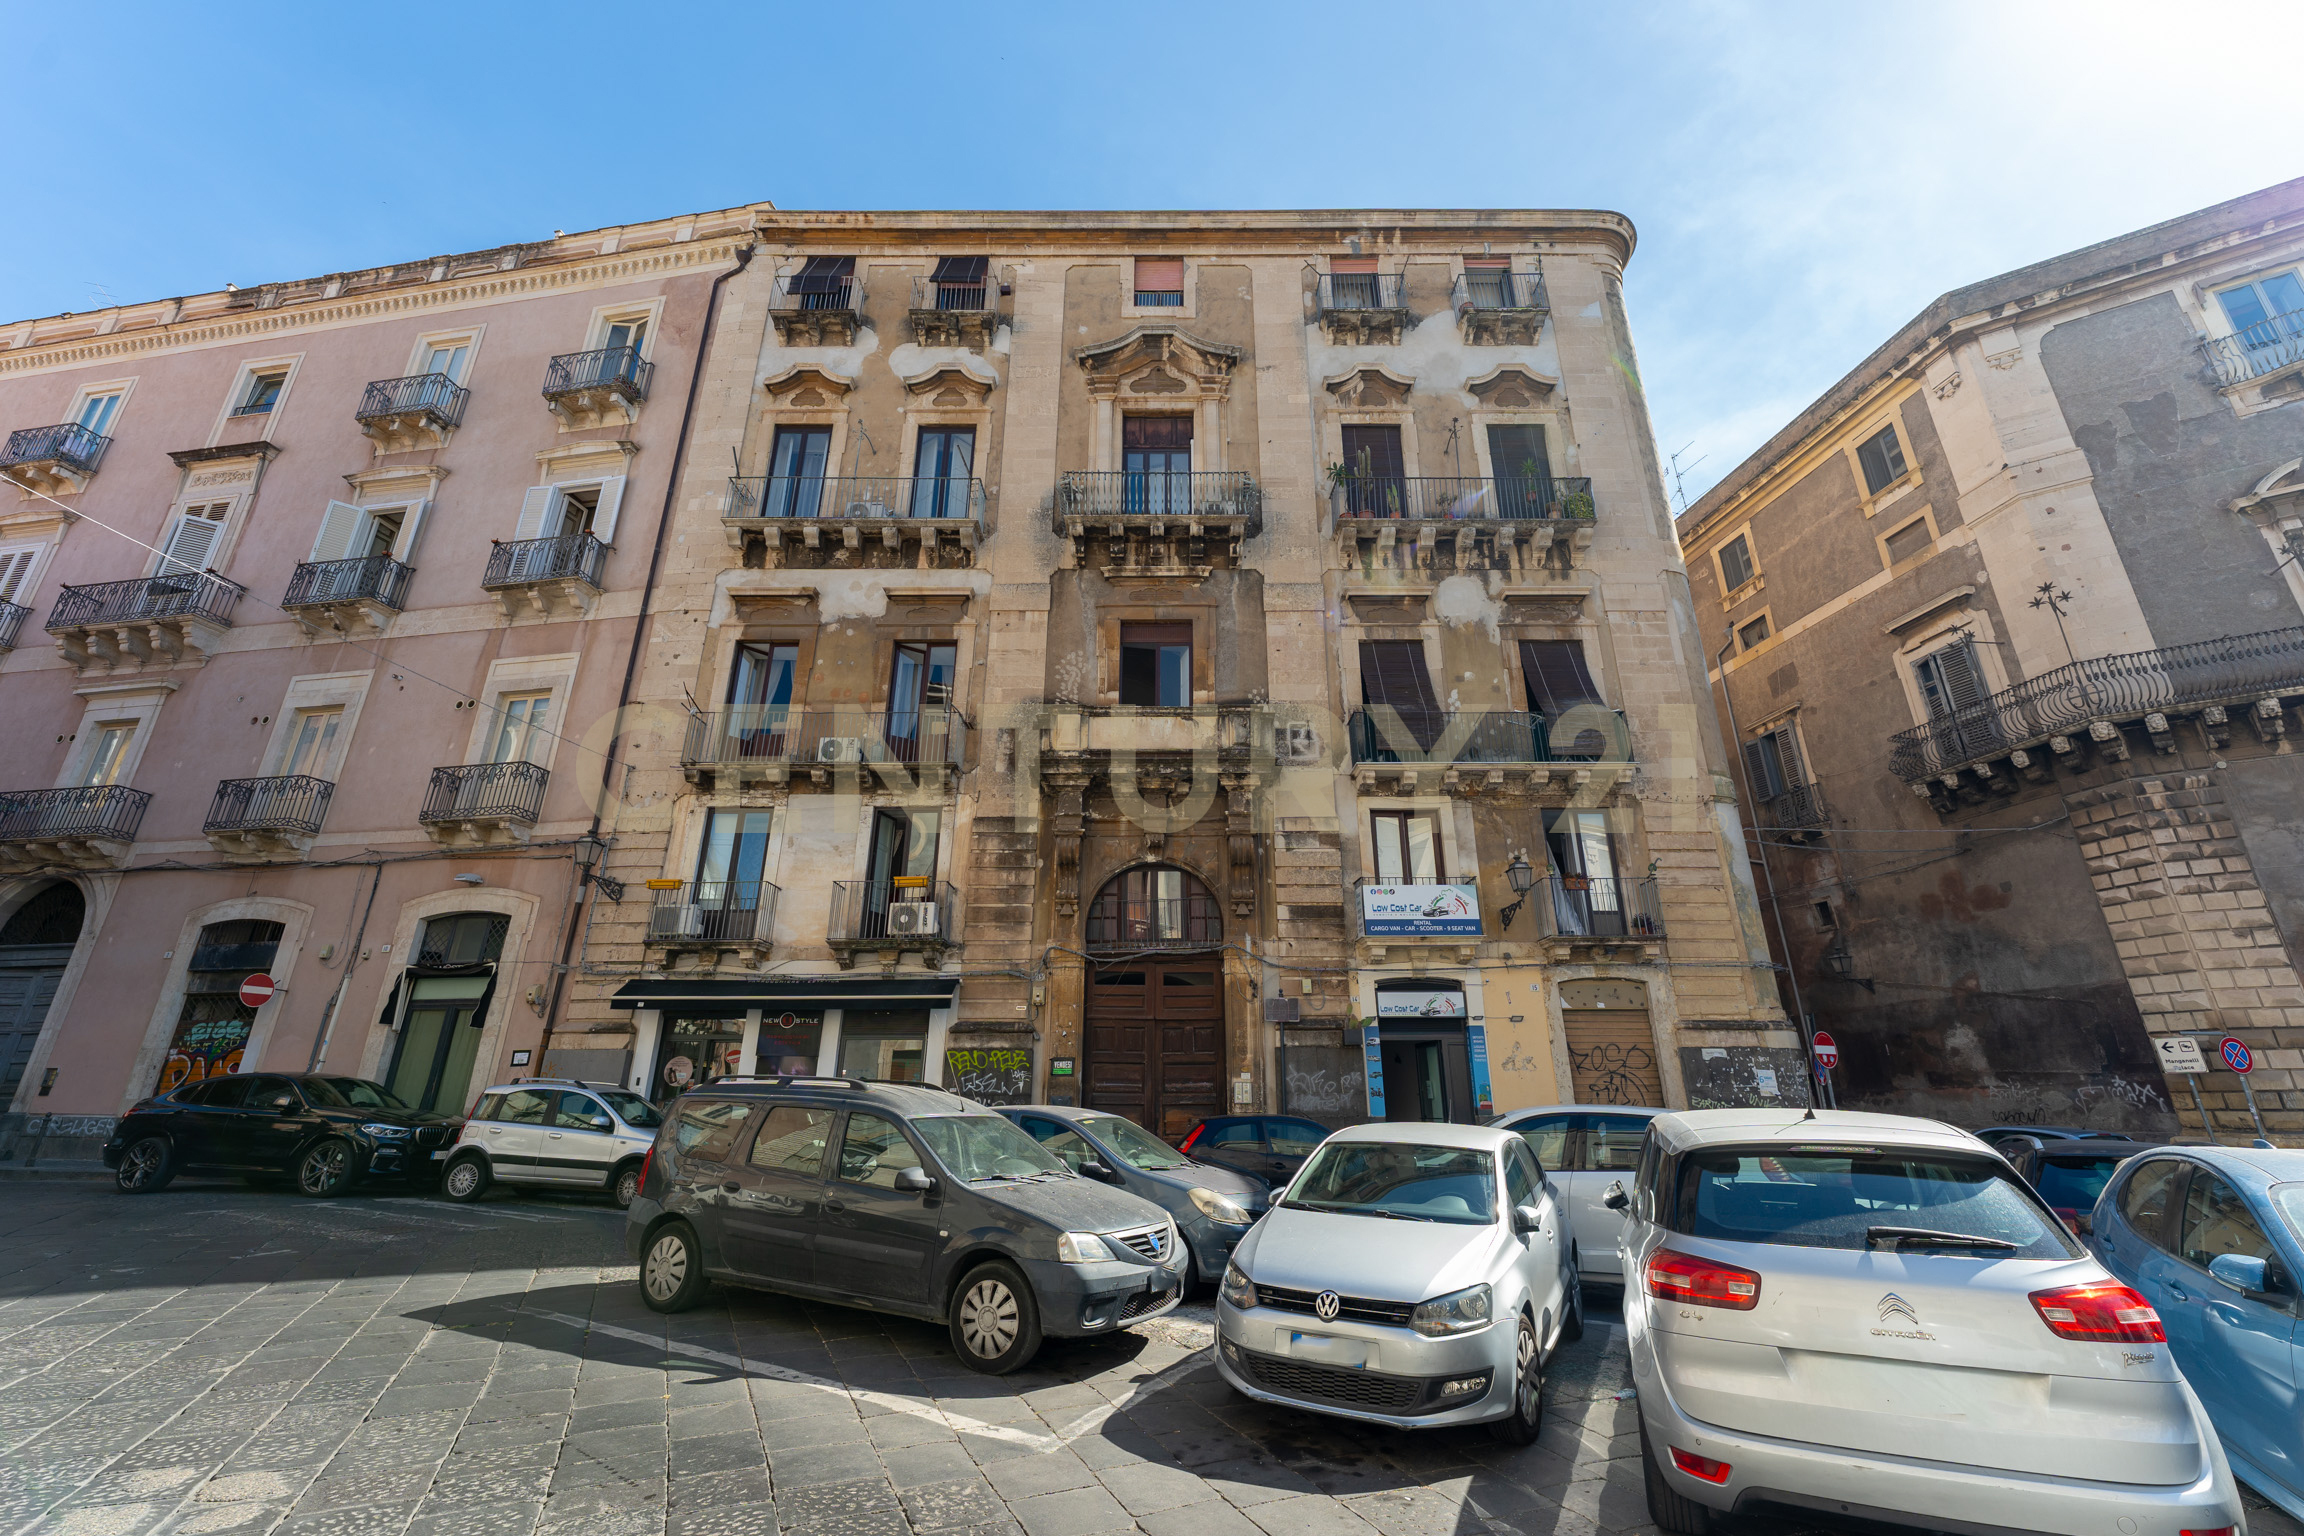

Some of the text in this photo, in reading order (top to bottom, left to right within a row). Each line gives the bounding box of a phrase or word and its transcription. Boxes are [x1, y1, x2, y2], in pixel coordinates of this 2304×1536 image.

[1371, 904, 1422, 912] Low Cost Car
[1679, 1309, 1704, 1321] C4
